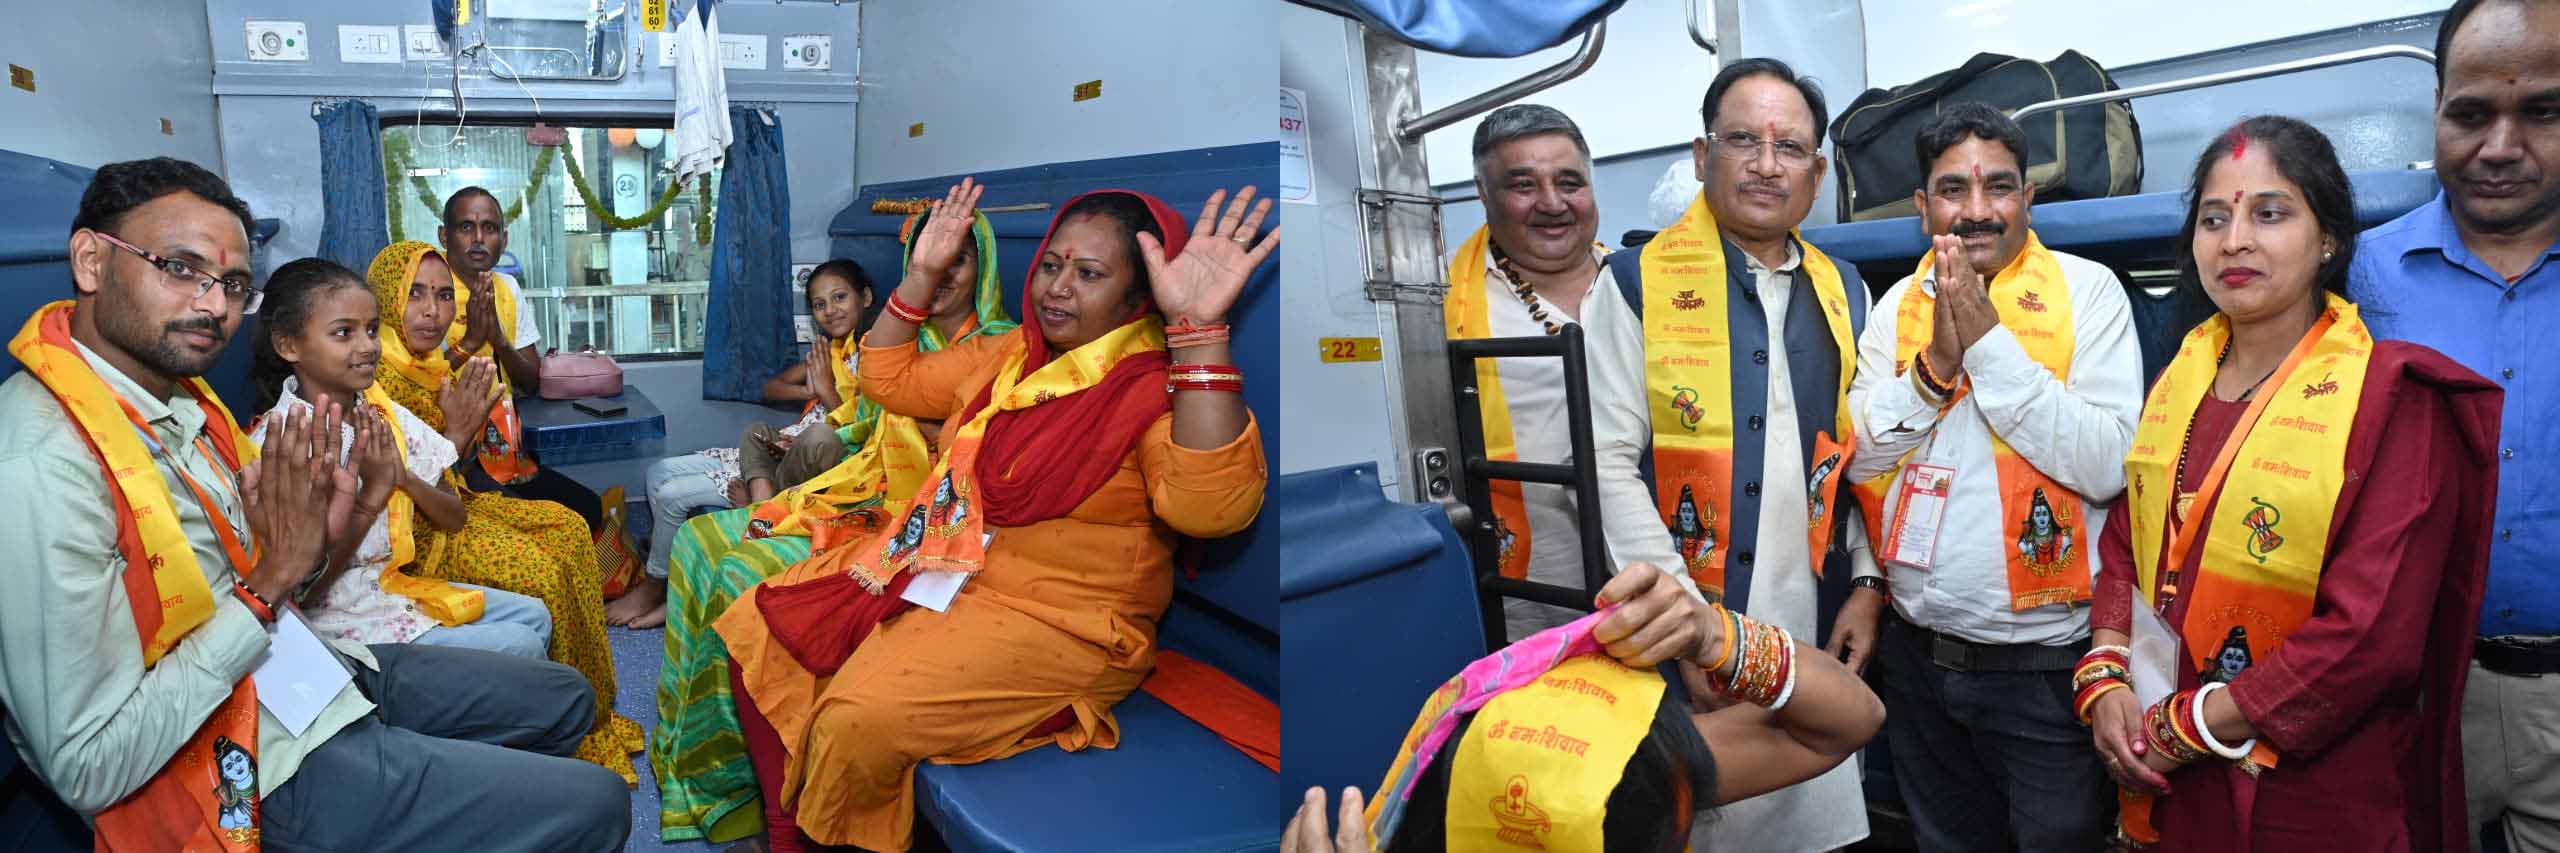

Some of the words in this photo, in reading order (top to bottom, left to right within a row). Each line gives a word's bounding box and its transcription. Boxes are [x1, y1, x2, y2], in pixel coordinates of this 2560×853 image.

[648, 6, 660, 15] 61
[648, 17, 660, 26] 60
[1331, 341, 1357, 359] 22
